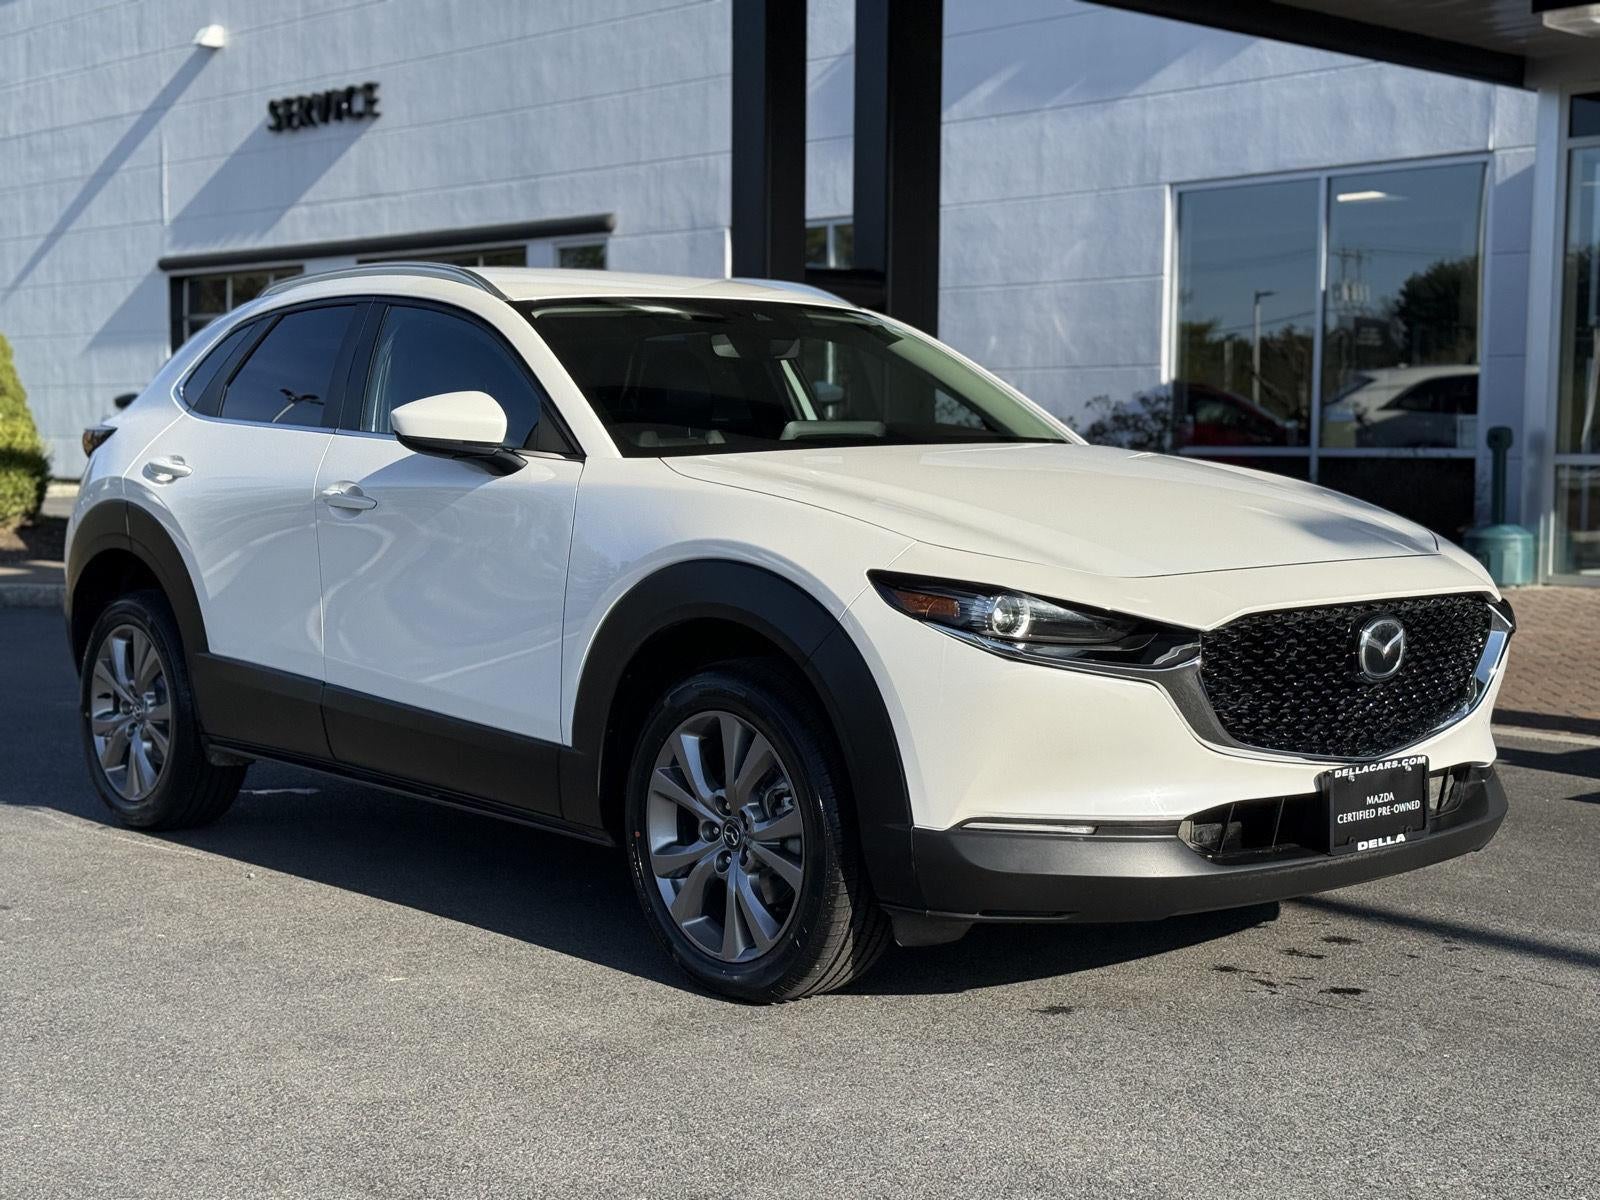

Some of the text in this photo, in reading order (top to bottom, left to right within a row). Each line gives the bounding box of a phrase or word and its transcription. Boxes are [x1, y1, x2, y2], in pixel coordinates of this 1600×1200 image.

[267, 82, 381, 132] SERVICE
[1334, 756, 1426, 778] DELLACARS.COM
[1366, 792, 1395, 805] MAZDA
[1337, 800, 1421, 824] CERTIFIED PRE-OWNED
[1357, 833, 1406, 851] DELLA
